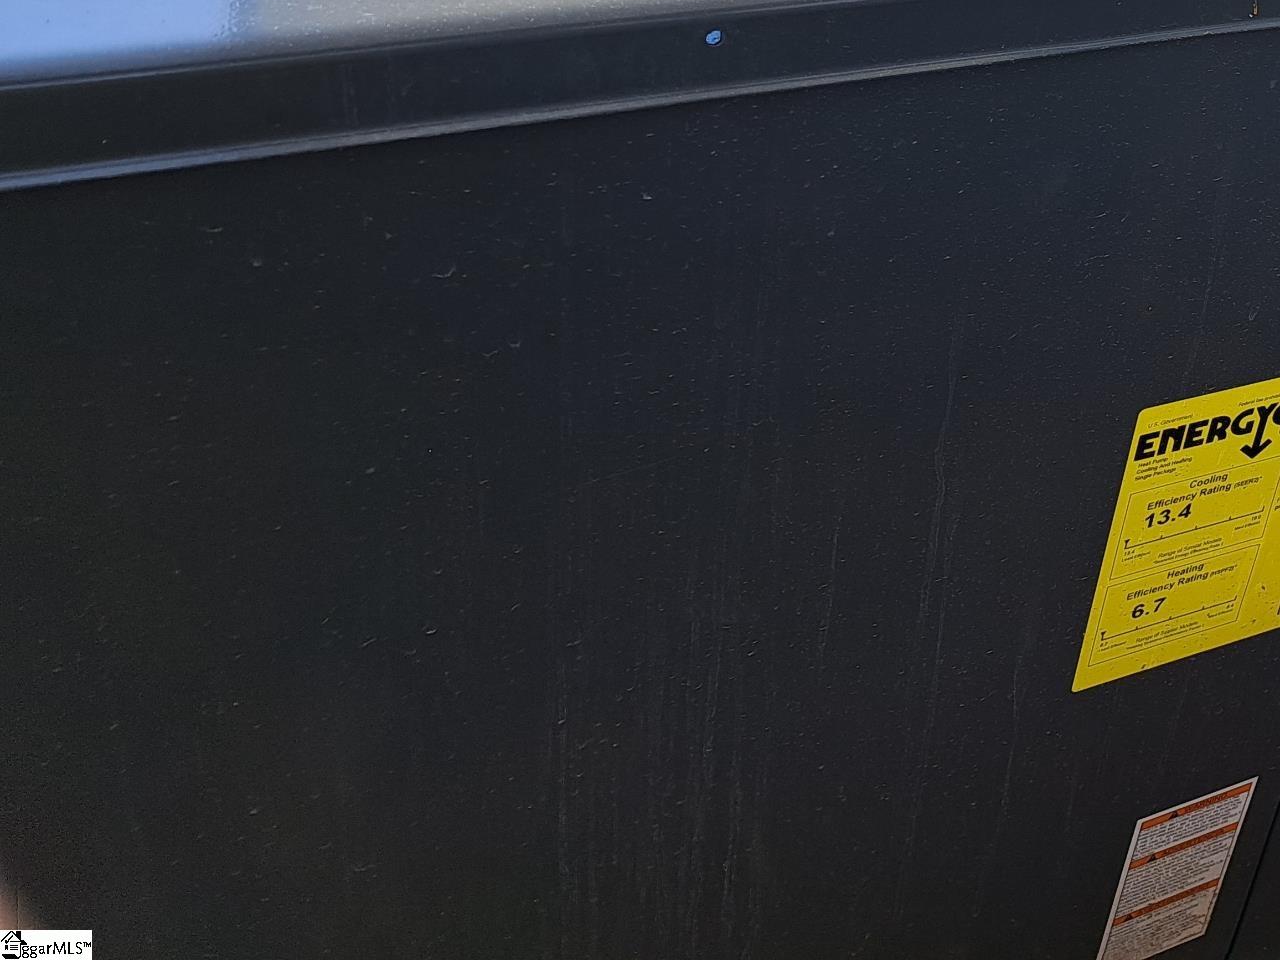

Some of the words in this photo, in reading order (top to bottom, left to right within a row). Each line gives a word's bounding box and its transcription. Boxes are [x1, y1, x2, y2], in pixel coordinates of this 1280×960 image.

[1160, 413, 1193, 425] Government
[1136, 463, 1160, 475] Cooling
[1171, 455, 1192, 466] Heating
[1151, 456, 1168, 465] Pump
[1134, 472, 1152, 482] Single
[1152, 466, 1176, 477] Package
[1188, 471, 1229, 490] Cooling
[1146, 490, 1198, 511] Efficiency
[1198, 481, 1232, 498] Rating
[1142, 501, 1194, 530] 13.4
[1157, 549, 1174, 559] Range
[1166, 561, 1205, 580] Heating
[1126, 580, 1175, 601] Efficiency
[1176, 570, 1209, 587] Rating
[1130, 596, 1166, 620] 6.7
